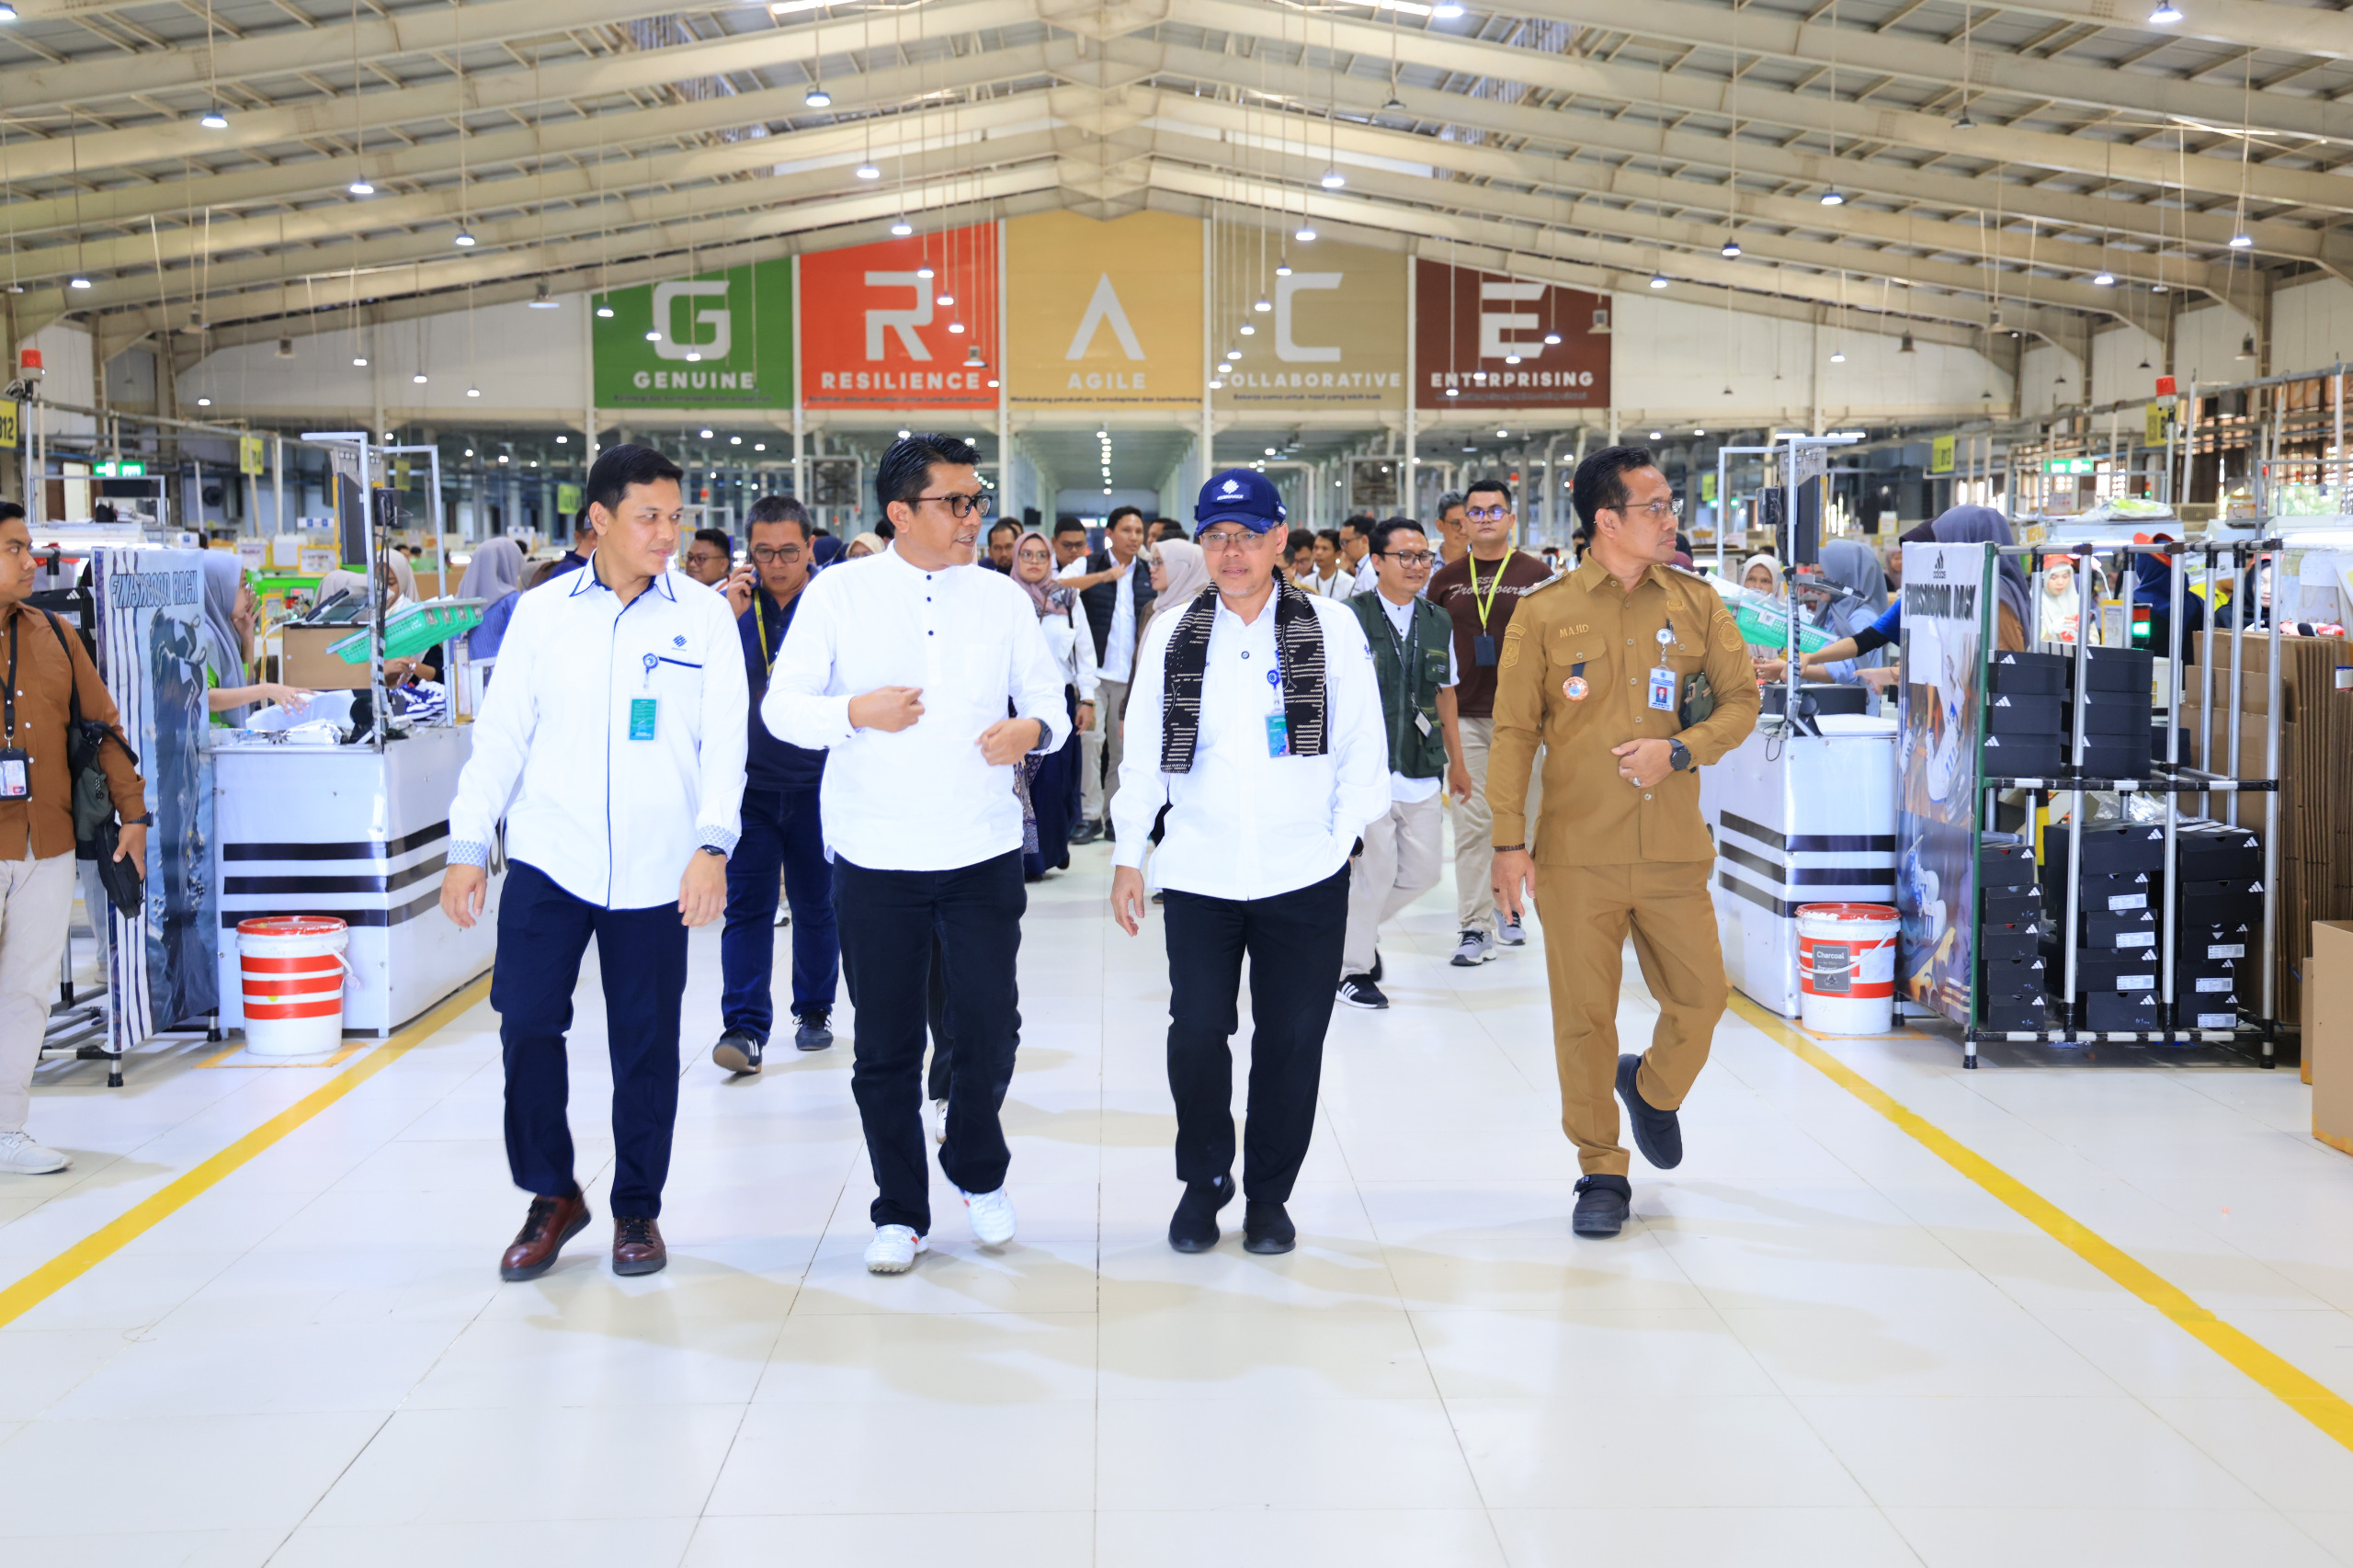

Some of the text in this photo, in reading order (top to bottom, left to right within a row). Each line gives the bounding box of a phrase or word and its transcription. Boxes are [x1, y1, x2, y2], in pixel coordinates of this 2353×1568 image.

[653, 280, 732, 360] G
[865, 270, 934, 360] R
[1065, 271, 1146, 360] A
[1275, 272, 1343, 362] C
[1480, 282, 1547, 358] E
[632, 370, 755, 390] GENUINE
[821, 371, 980, 390] RESILIENCE
[1067, 372, 1146, 390] AGILE
[1216, 371, 1402, 388] COLLABORATIVE
[1430, 370, 1594, 388] ENTERPRISING
[0, 415, 14, 440] 12
[1559, 623, 1589, 639] MAJID
[1816, 950, 1845, 960] Charcoal
